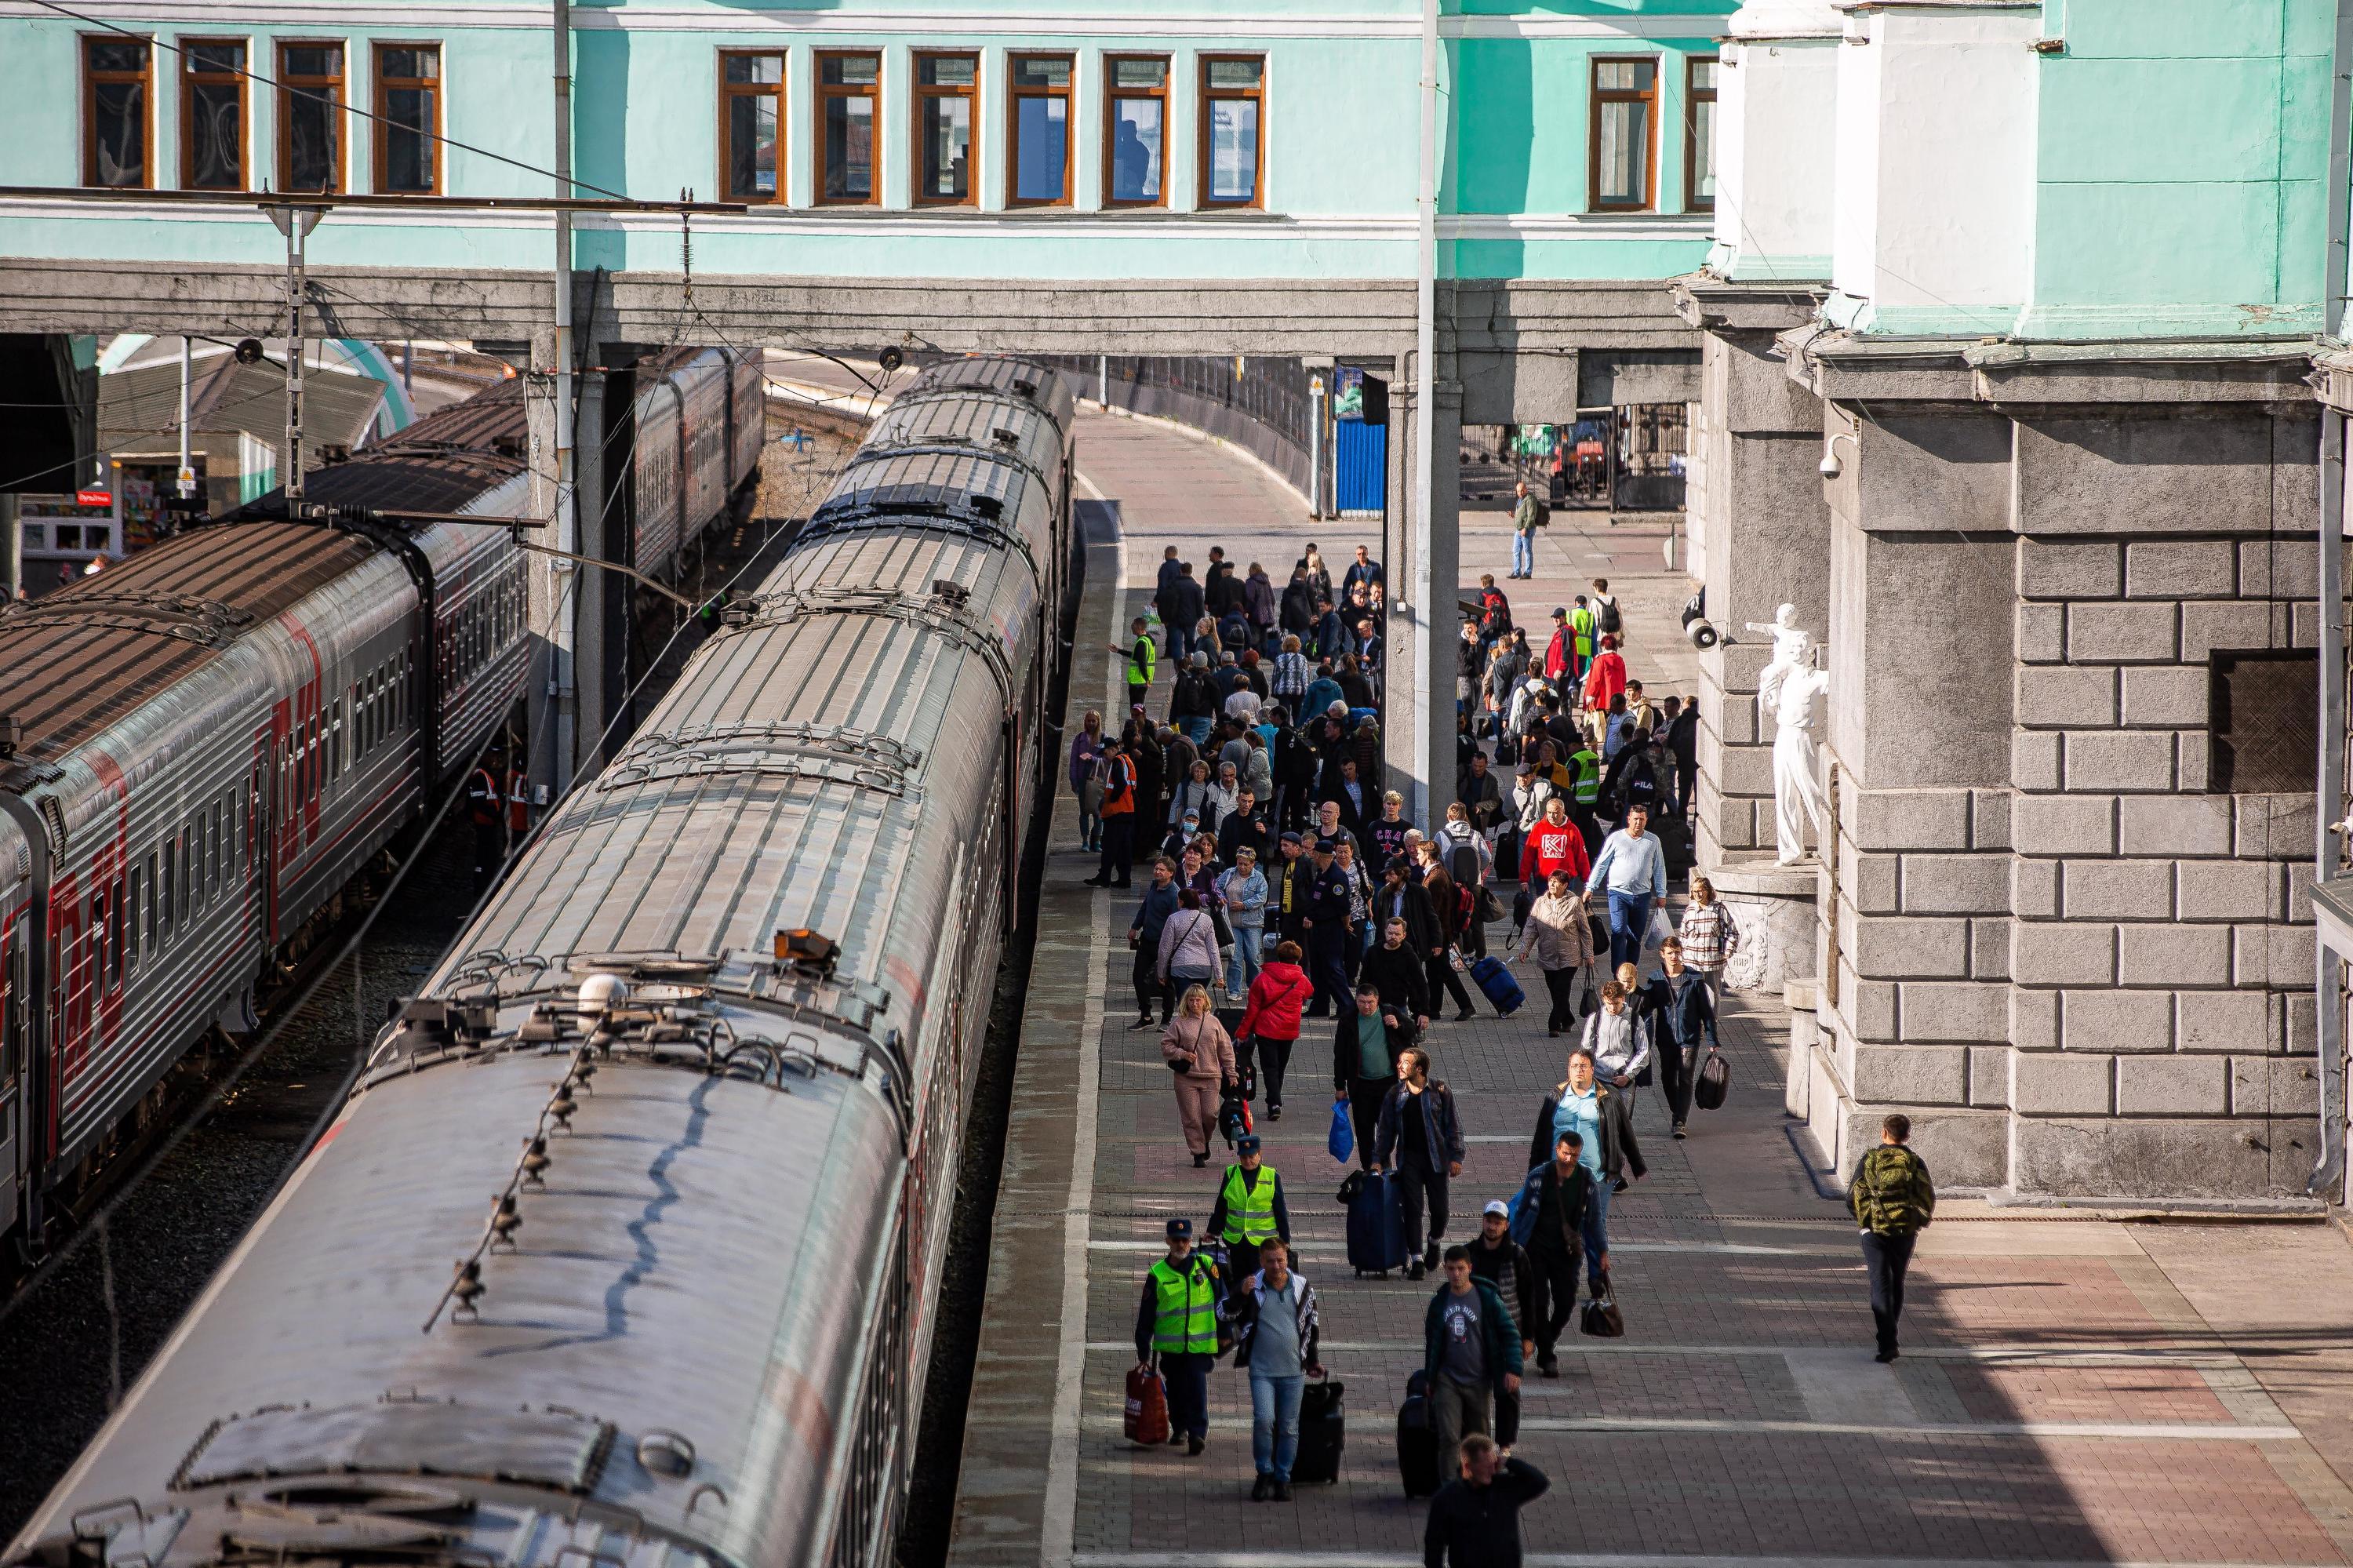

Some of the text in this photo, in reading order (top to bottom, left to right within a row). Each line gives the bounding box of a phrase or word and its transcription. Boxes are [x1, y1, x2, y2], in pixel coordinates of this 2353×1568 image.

[1634, 780, 1653, 790] FILA
[1377, 829, 1402, 842] СКА
[1733, 958, 1749, 967] МИР
[1445, 1305, 1461, 1323] EER
